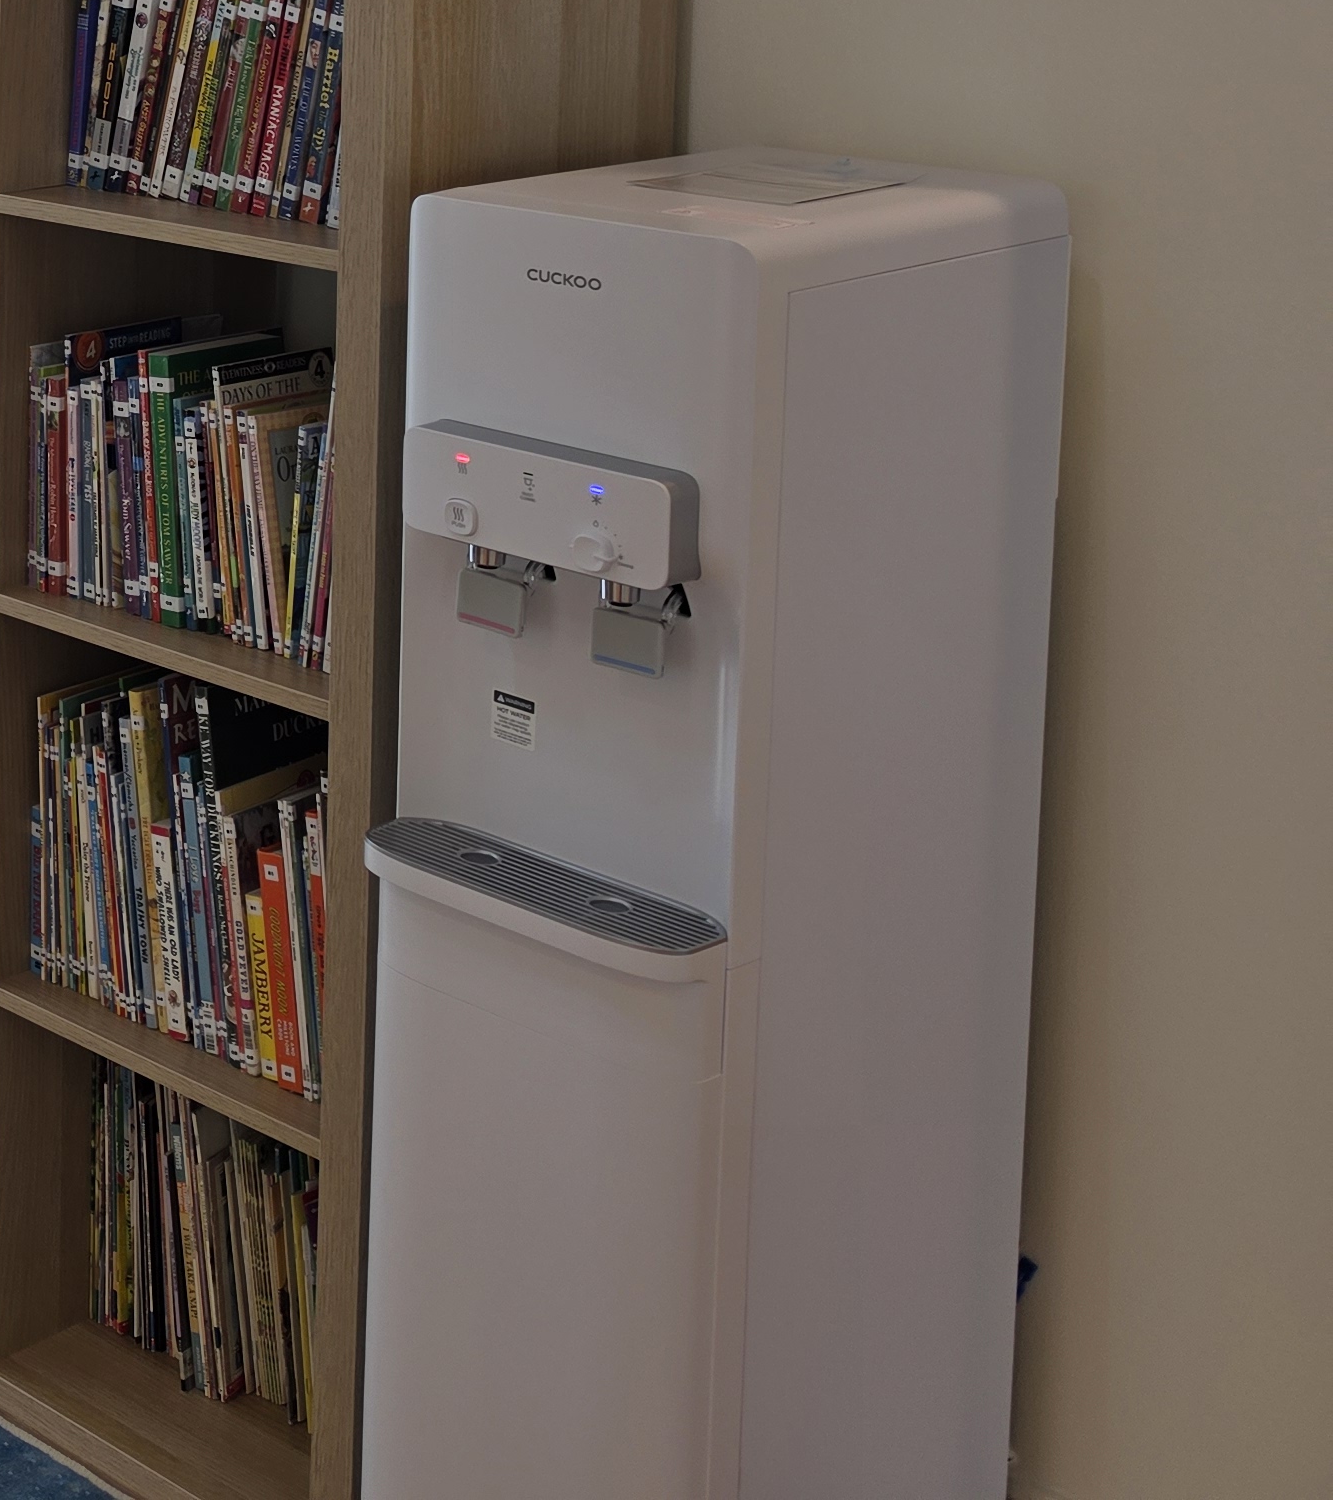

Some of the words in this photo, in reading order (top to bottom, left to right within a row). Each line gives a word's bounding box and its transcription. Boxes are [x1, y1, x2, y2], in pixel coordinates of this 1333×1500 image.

[296, 50, 305, 68] OUT
[101, 42, 118, 118] HOOT
[294, 70, 301, 81] OF
[319, 47, 340, 109] Harriet
[285, 84, 299, 128] DARKNESS
[318, 111, 327, 124] the
[527, 268, 602, 290] CUCKOO
[315, 359, 325, 378] 4
[156, 392, 166, 412] THE
[222, 387, 254, 406] DAYS
[257, 384, 273, 398] OF
[276, 377, 302, 394] THE
[84, 440, 93, 468] RAMONA
[157, 417, 170, 490] ADVENTURES
[84, 484, 93, 504] PEST
[161, 493, 170, 507] OF
[162, 511, 171, 535] TOM
[191, 501, 201, 521] JUDY
[193, 522, 203, 550] MOODY
[164, 539, 174, 585] SAWYER
[200, 739, 212, 766] WAY
[203, 769, 216, 796] FOR
[205, 802, 224, 880] DUCKLINGS
[154, 867, 163, 886] WHO
[190, 853, 200, 883] Love
[163, 881, 174, 905] THERE
[155, 888, 166, 943] SWALLOWED
[165, 906, 175, 923] WAS
[167, 925, 175, 938] AN
[235, 920, 245, 949] GOLD
[139, 933, 149, 964] TOWN
[168, 941, 177, 958] OLD
[268, 905, 284, 976] GOODNIGHT
[276, 980, 288, 1016] MOON
[161, 955, 171, 986] SHELL!
[169, 960, 180, 982] LADY
[237, 955, 249, 994] FEVER
[252, 933, 273, 1040] JAMBERRY
[281, 1020, 291, 1056] MILESTONE
[171, 1135, 183, 1170] Willems
[183, 1235, 193, 1257] WILL
[185, 1261, 195, 1285] TAKE
[189, 1298, 199, 1319] NAP!
